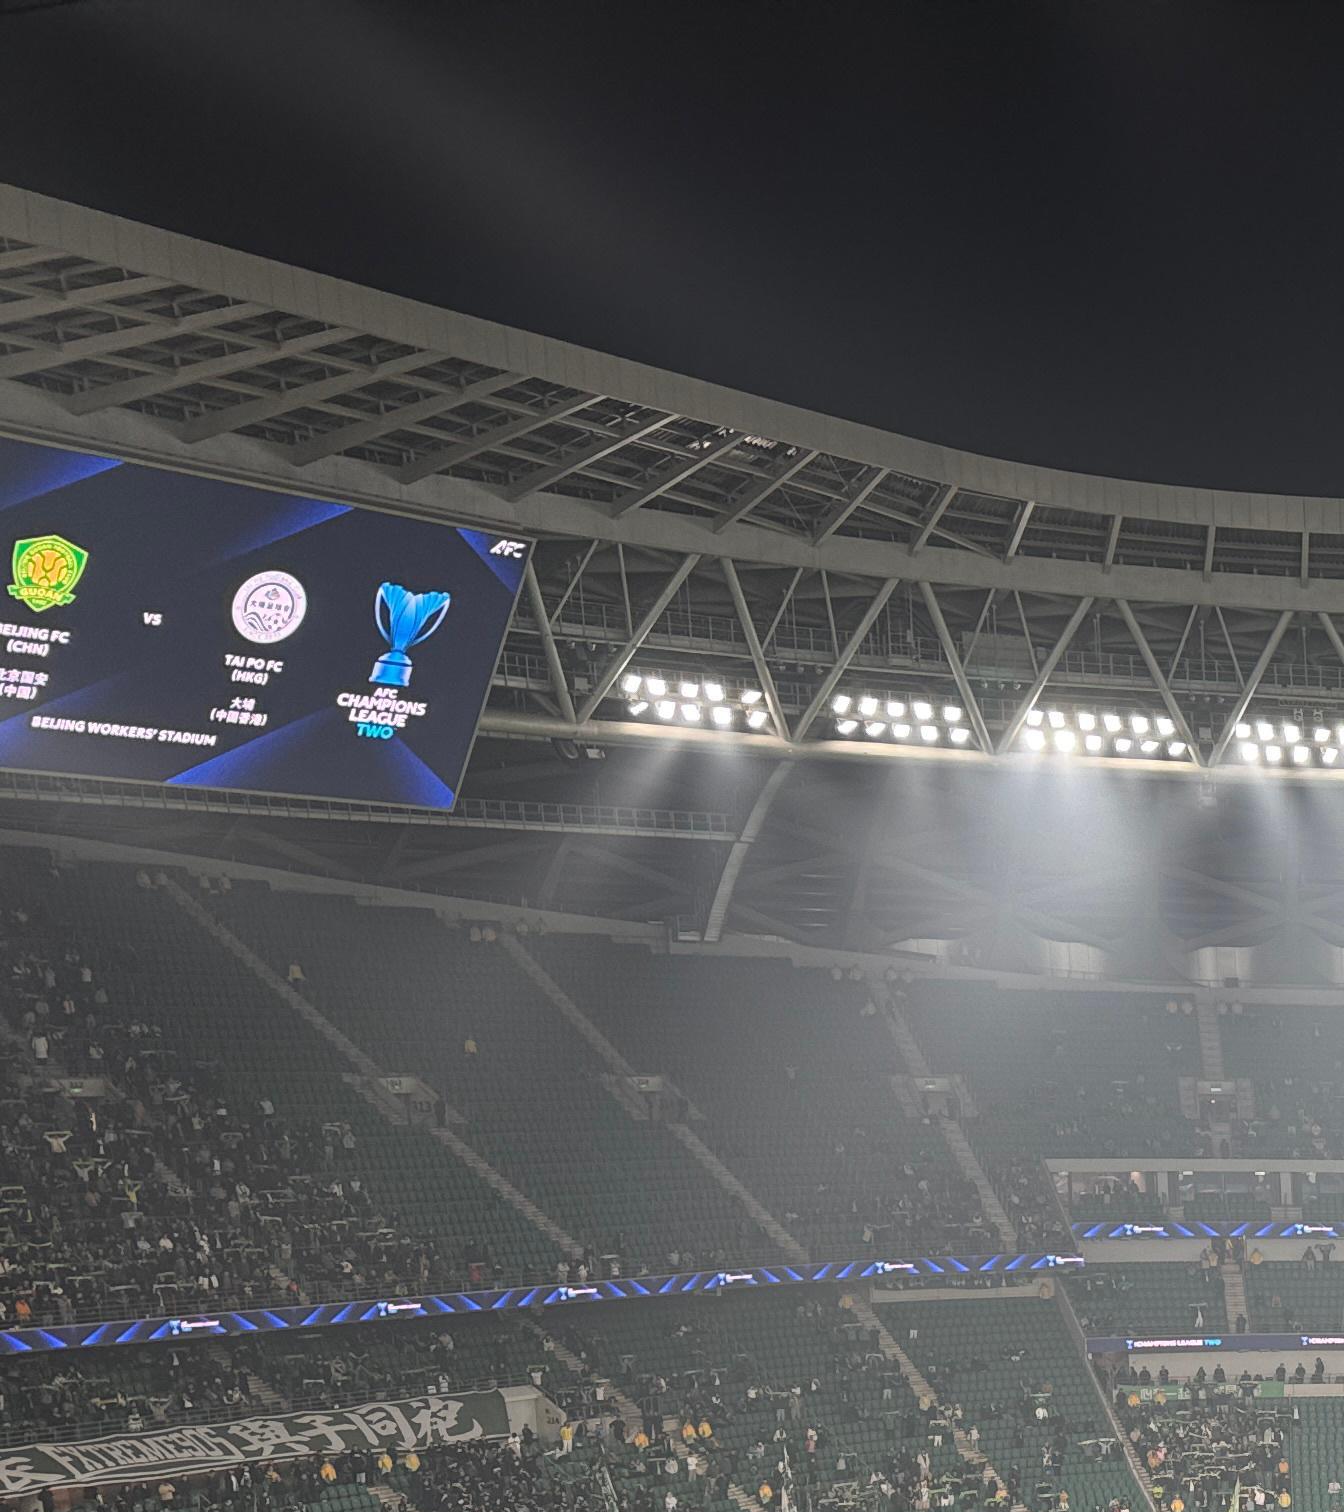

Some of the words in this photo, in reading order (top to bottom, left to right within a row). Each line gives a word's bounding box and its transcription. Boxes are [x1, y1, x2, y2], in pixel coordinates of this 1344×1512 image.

[490, 540, 526, 558] AFC
[50, 630, 71, 645] FC
[6, 639, 50, 657] (CHN)
[225, 655, 246, 668] TAI
[247, 657, 265, 670] PO
[267, 659, 284, 673] FC
[231, 669, 269, 686] (HKG)
[373, 688, 398, 699] AFC
[337, 693, 428, 716] CHAMPIONS
[348, 708, 409, 728] LEAGUE
[31, 715, 86, 733] BEIJING
[158, 728, 217, 747] STADIUM
[356, 722, 395, 740] TWO
